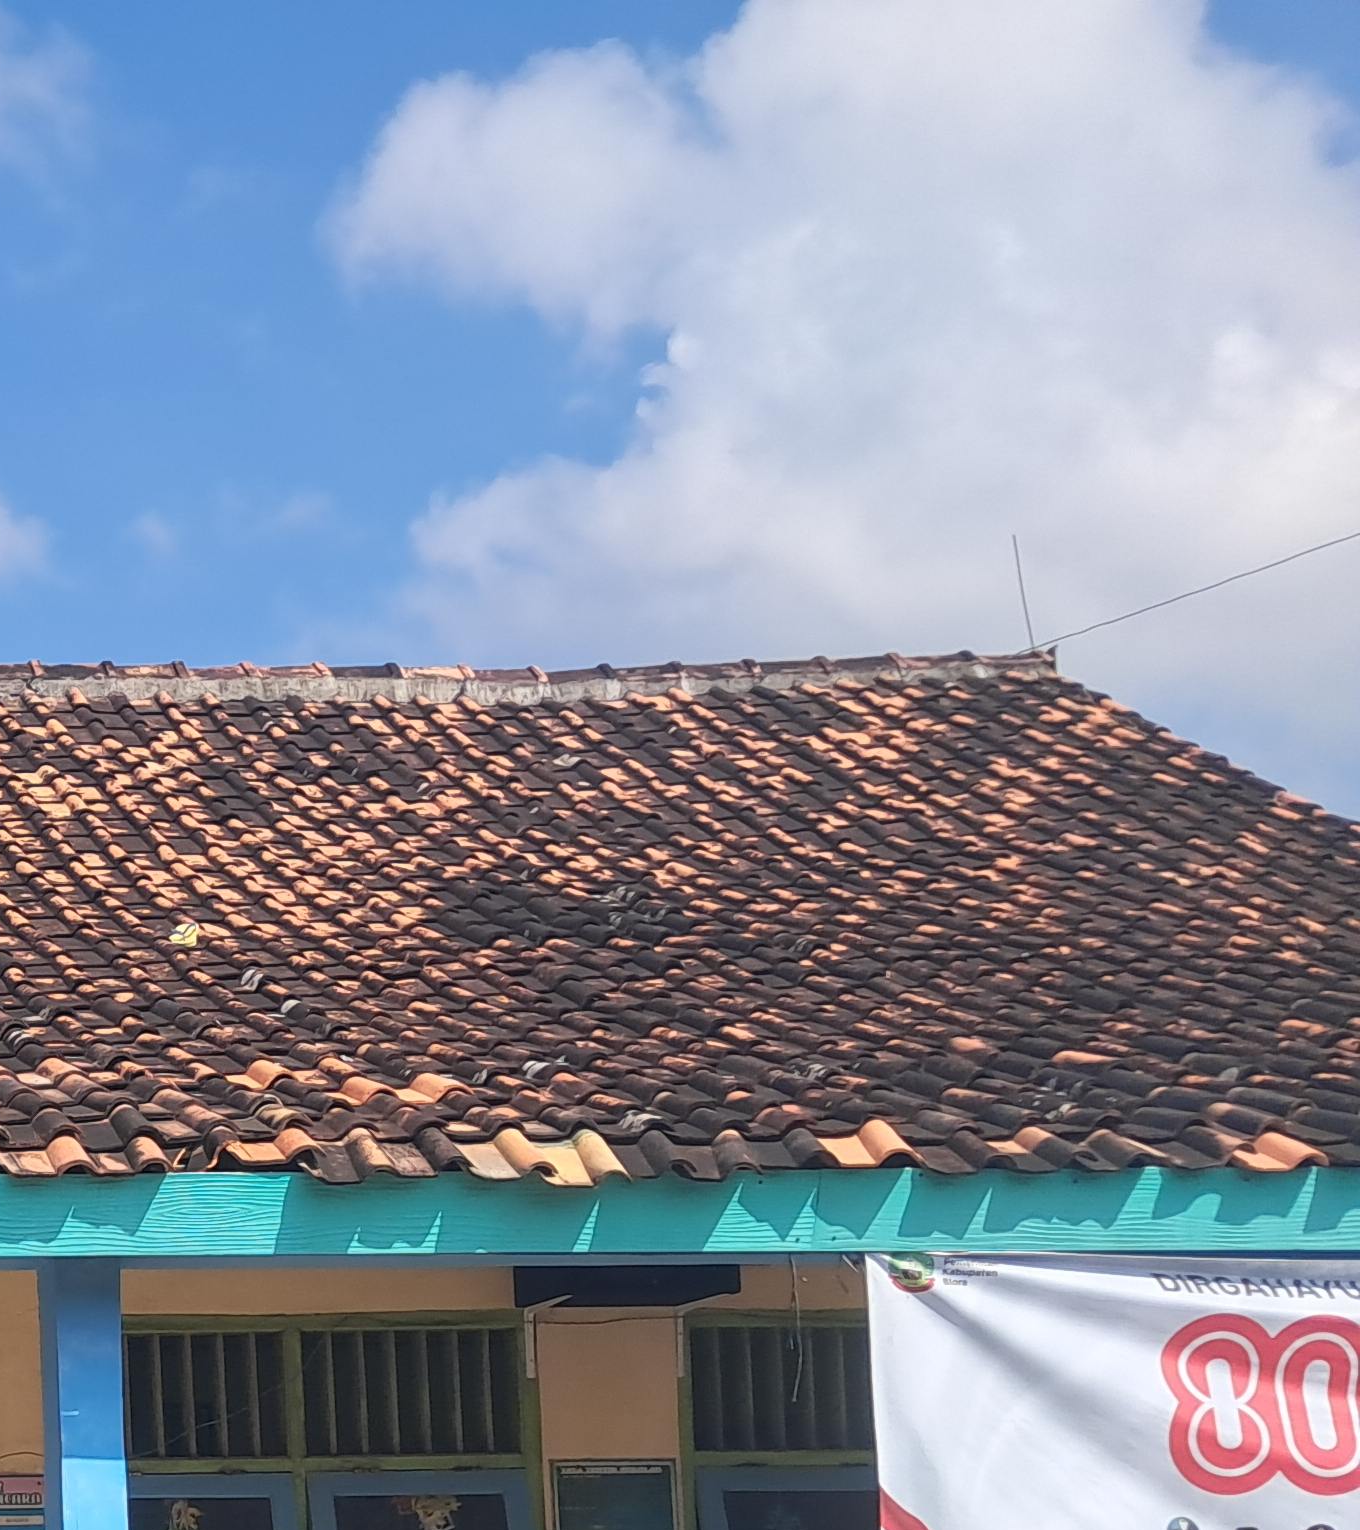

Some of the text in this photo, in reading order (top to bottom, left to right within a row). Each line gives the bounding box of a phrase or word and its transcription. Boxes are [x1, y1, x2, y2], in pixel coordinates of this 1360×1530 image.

[942, 1268, 998, 1277] Kabupaten
[1150, 1273, 1360, 1300] DIRGAHAYU
[1160, 1313, 1360, 1496] 80
